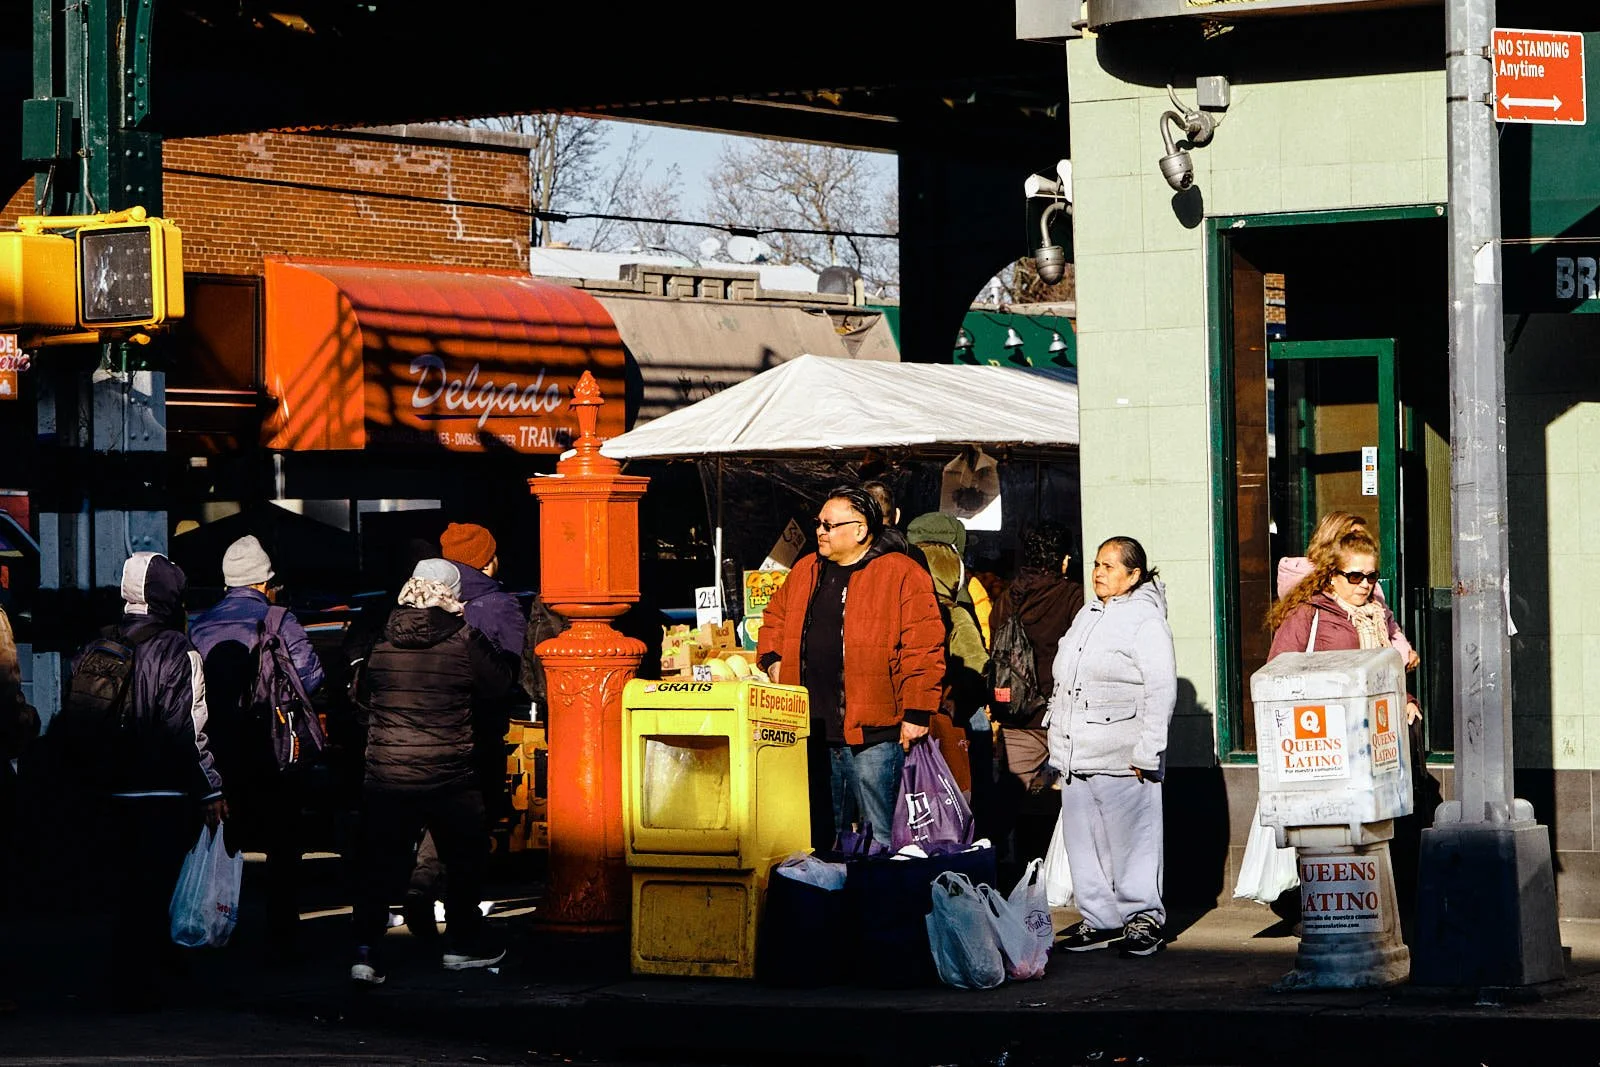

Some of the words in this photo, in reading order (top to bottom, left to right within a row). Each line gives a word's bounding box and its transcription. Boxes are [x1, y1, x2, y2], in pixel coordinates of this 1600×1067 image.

[1498, 38, 1514, 56] NO
[1516, 40, 1569, 58] STANDING
[1500, 60, 1545, 80] Anytime
[1556, 256, 1600, 299] BR
[410, 354, 562, 429] Delgado
[657, 682, 713, 693] GRATIS
[750, 688, 759, 707] El
[760, 689, 807, 715] Especialito
[1300, 710, 1321, 734] Q
[761, 728, 797, 744] GRATIS
[1372, 732, 1396, 750] QUEENS
[1281, 738, 1342, 755] QUEENS
[1374, 746, 1397, 763] LATINO
[1285, 754, 1343, 769] LATINO
[1301, 861, 1377, 883] UEENS
[1301, 891, 1379, 913] ATINO
